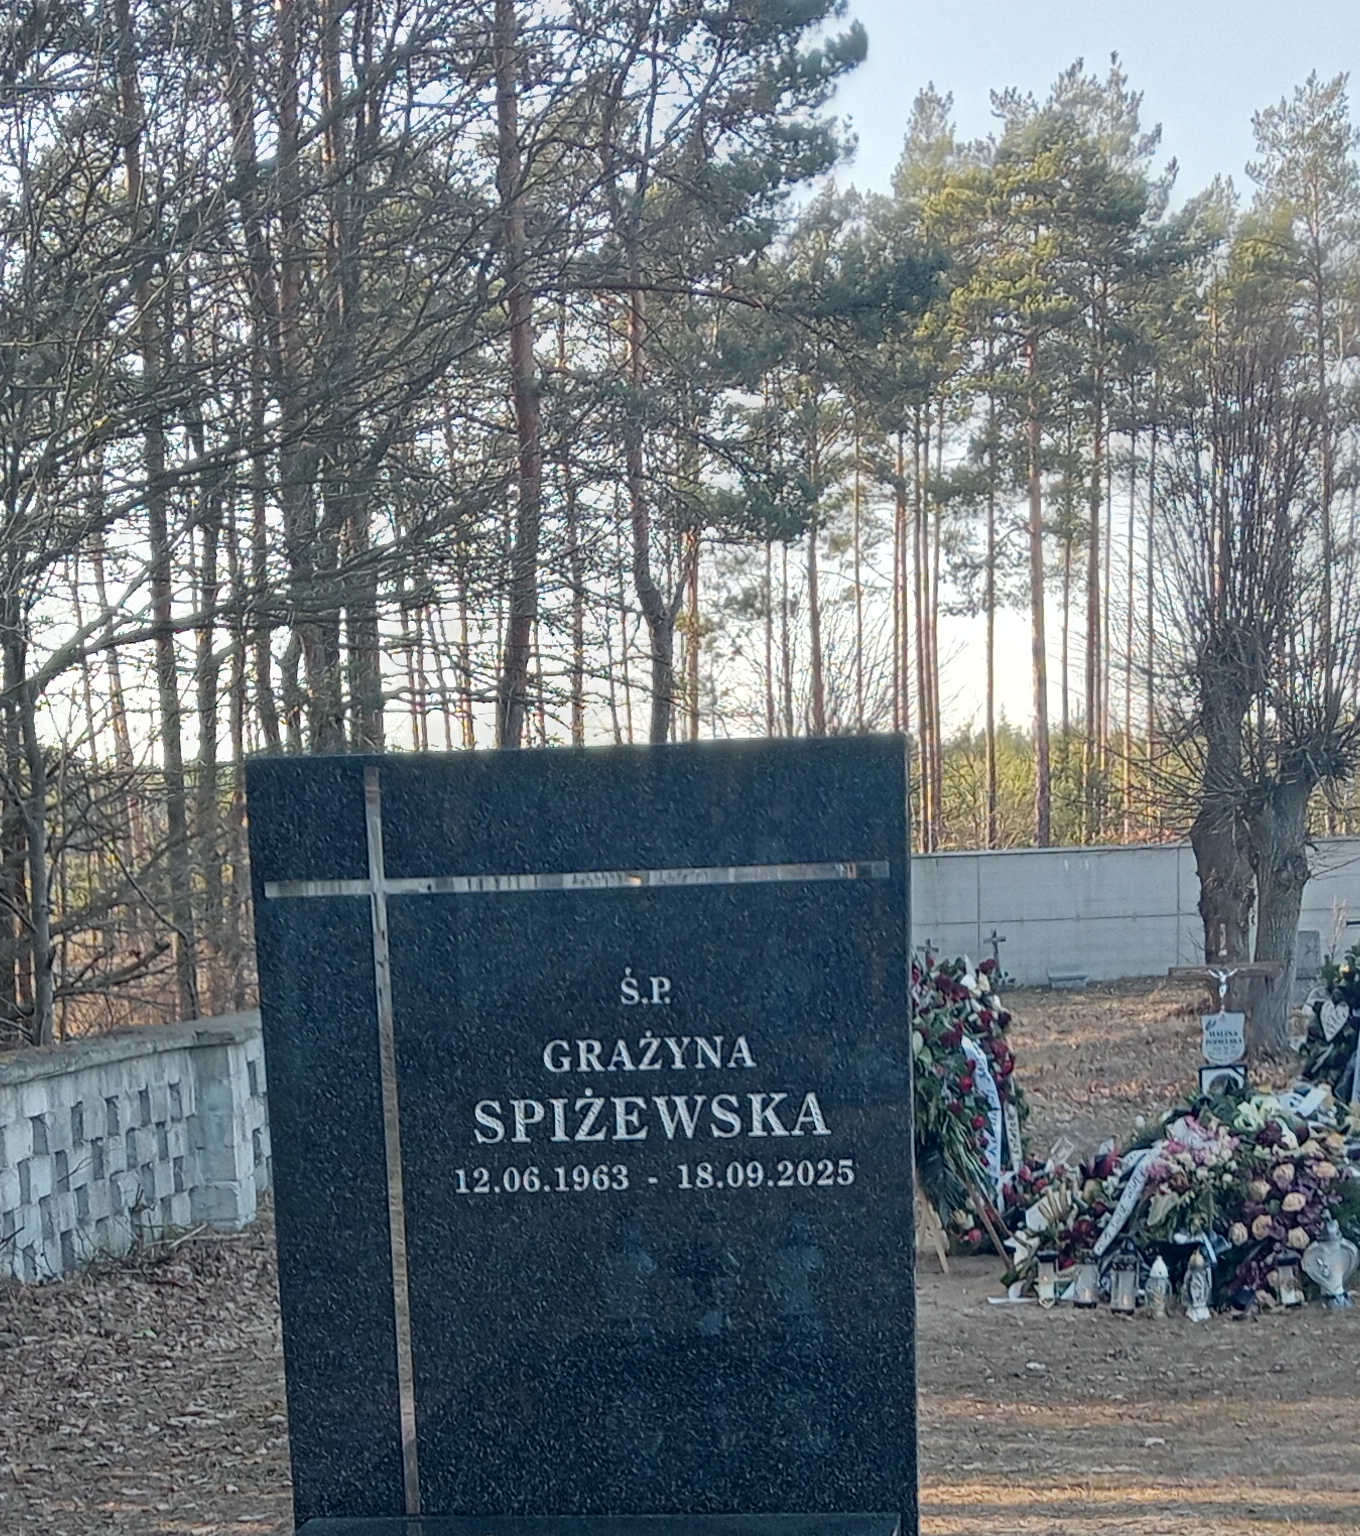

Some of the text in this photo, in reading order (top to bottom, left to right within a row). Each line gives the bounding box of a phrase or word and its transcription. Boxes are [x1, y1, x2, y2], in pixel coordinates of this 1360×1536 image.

[620, 967, 672, 1004] Ś.P.
[543, 1029, 757, 1074] GRAŻYNA
[474, 1087, 832, 1145] SPIŻEWSKA
[454, 1165, 630, 1194] 12.06.1963
[677, 1159, 856, 1190] 18.09.2025
